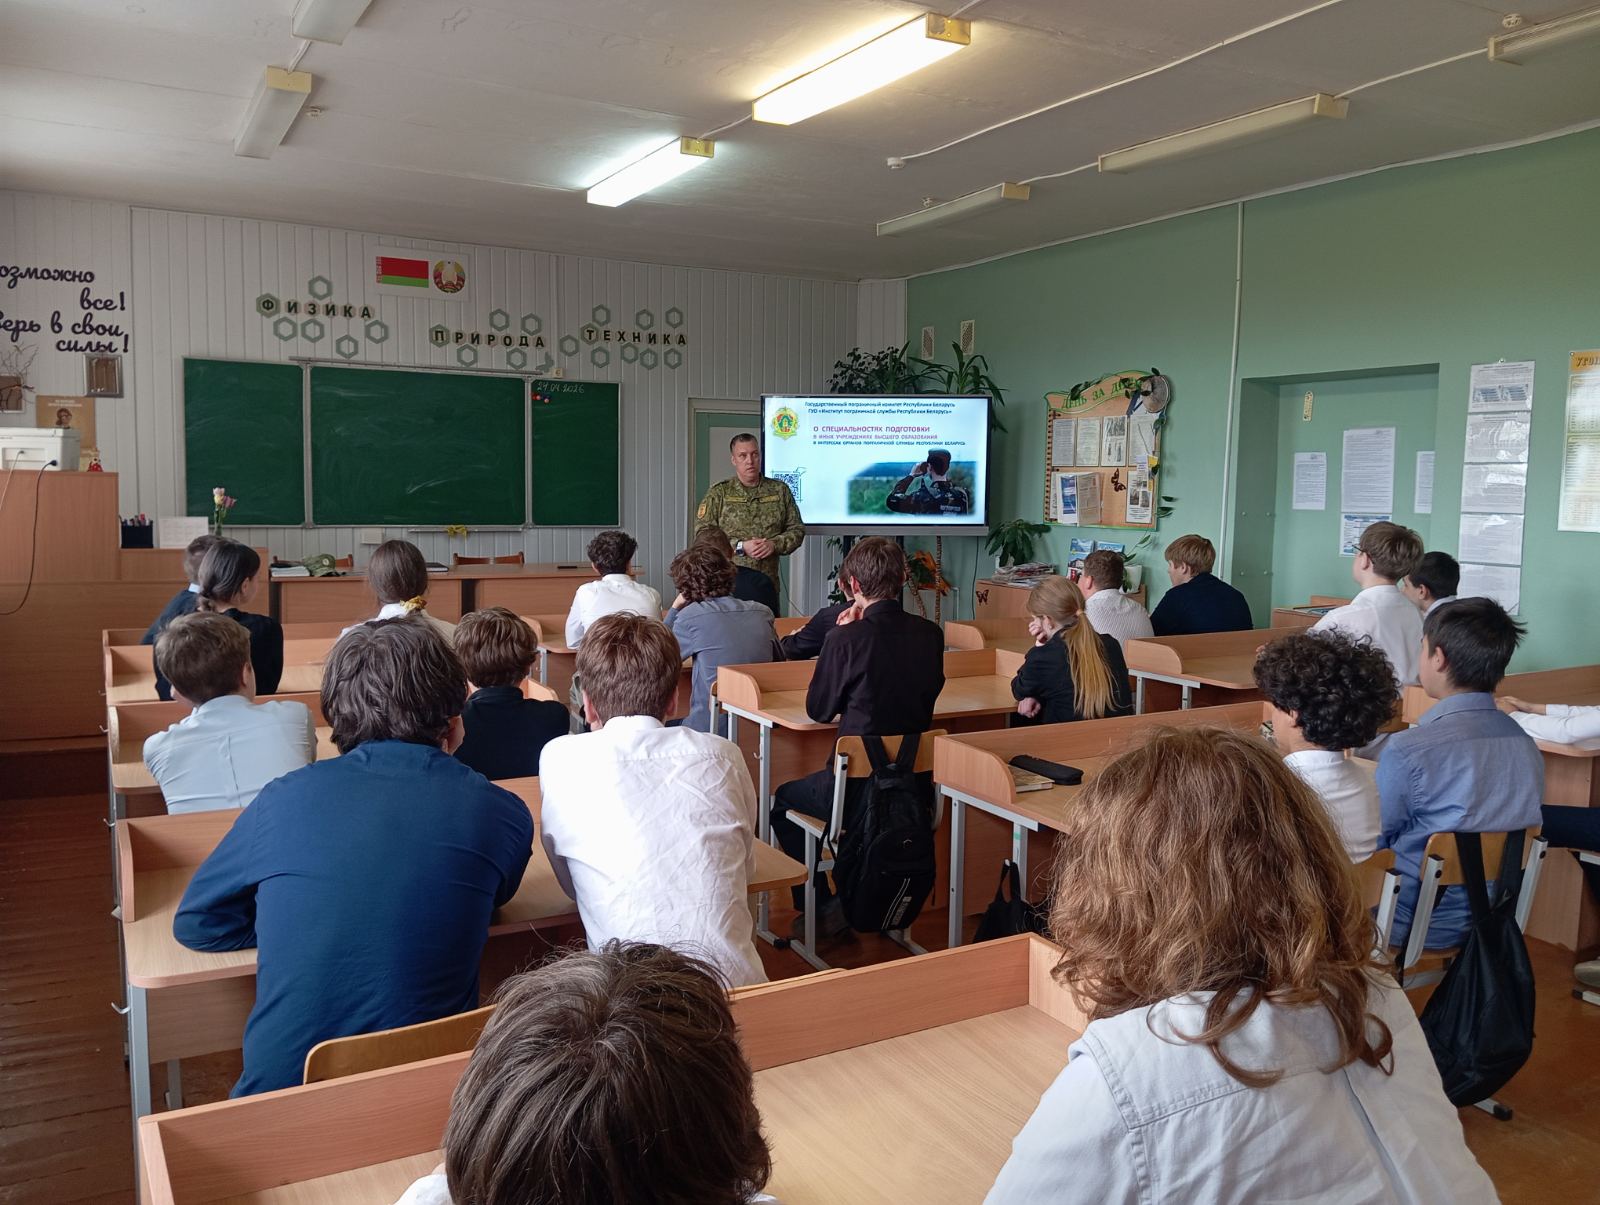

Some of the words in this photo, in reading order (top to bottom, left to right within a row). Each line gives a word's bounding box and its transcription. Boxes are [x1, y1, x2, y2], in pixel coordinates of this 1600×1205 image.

[80, 287, 125, 311] все!
[261, 299, 371, 319] ФИЗИКА
[50, 310, 63, 334] в
[71, 312, 124, 337] свои
[56, 334, 129, 353] силы!
[434, 330, 545, 348] ПРИРОДА
[586, 329, 687, 345] ТЕХНИКА
[1092, 388, 1105, 401] ЗА
